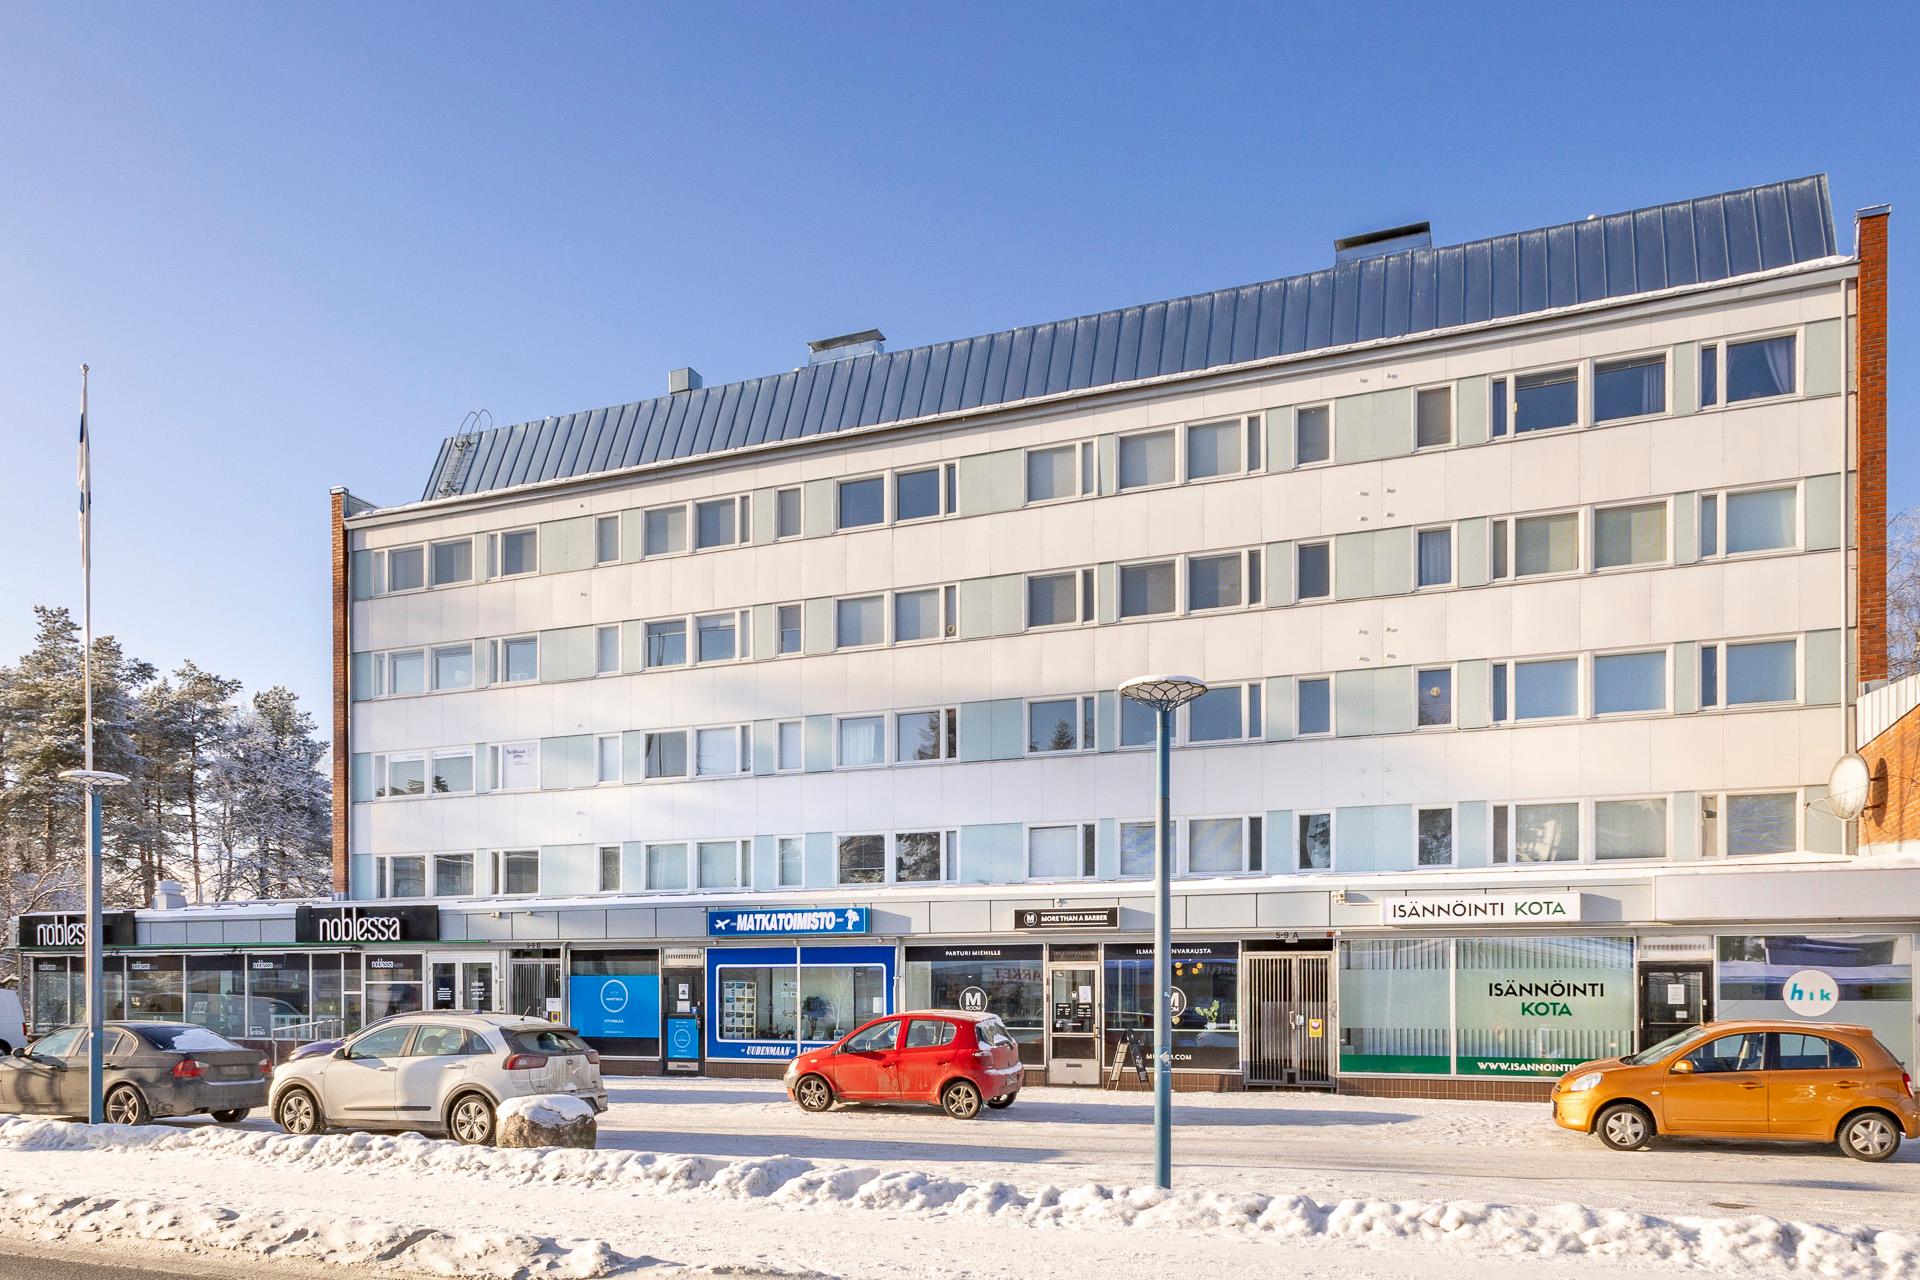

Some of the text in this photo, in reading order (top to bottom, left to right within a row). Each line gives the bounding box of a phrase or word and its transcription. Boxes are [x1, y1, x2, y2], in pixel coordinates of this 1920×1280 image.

[1393, 899, 1567, 918] ISÄNNÖINTI KOTA
[36, 914, 86, 946] nobles
[319, 907, 400, 941] noblessa
[736, 911, 836, 931] MATKATOIMISTO
[1275, 931, 1300, 939] 5-9 A
[1489, 979, 1604, 997] ISÄNNÖINTI
[965, 992, 981, 1005] M
[1521, 1002, 1572, 1016] KOTA
